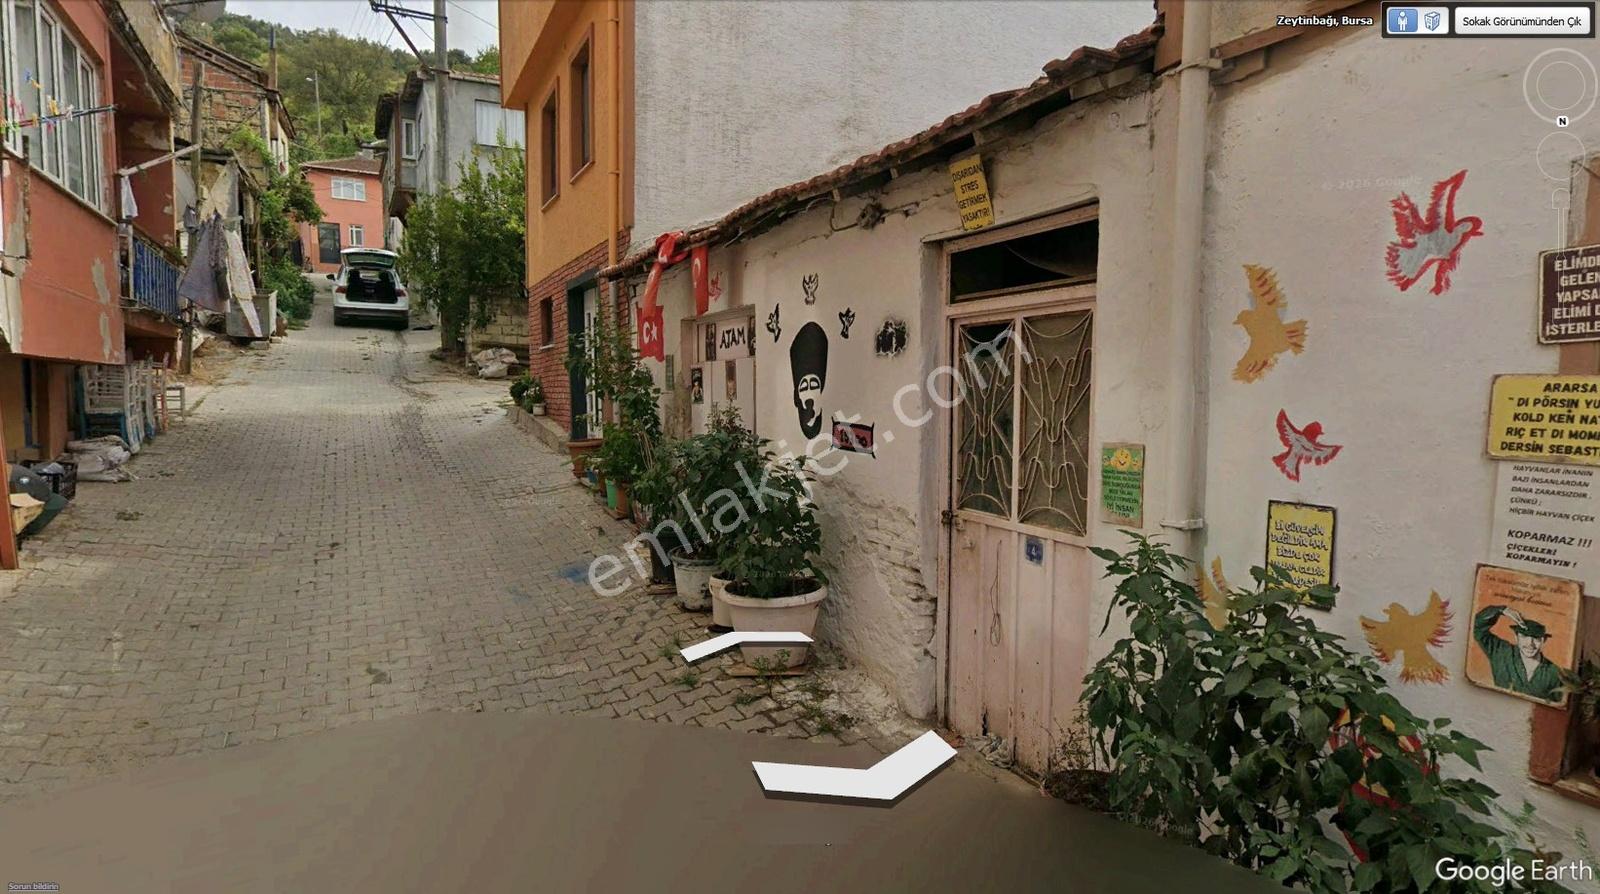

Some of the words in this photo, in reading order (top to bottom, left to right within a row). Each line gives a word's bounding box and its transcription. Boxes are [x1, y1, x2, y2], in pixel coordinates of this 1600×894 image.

[960, 180, 979, 194] STRES
[1553, 302, 1591, 319] ELİMİ
[719, 326, 746, 349] ATAM
[1543, 382, 1598, 393] ARARSA
[1513, 412, 1545, 423] KOLD
[1548, 413, 1575, 424] KEN
[1579, 414, 1600, 425] NA
[1530, 428, 1547, 438] ET
[1500, 440, 1543, 453] DERSİN
[1512, 465, 1561, 475] HAYVANLAR
[1511, 486, 1533, 494] DAHA
[1536, 510, 1570, 520] HAYVAN
[1507, 529, 1576, 546] KOPARMAZ
[1505, 552, 1571, 568] KOPARMAYIN
